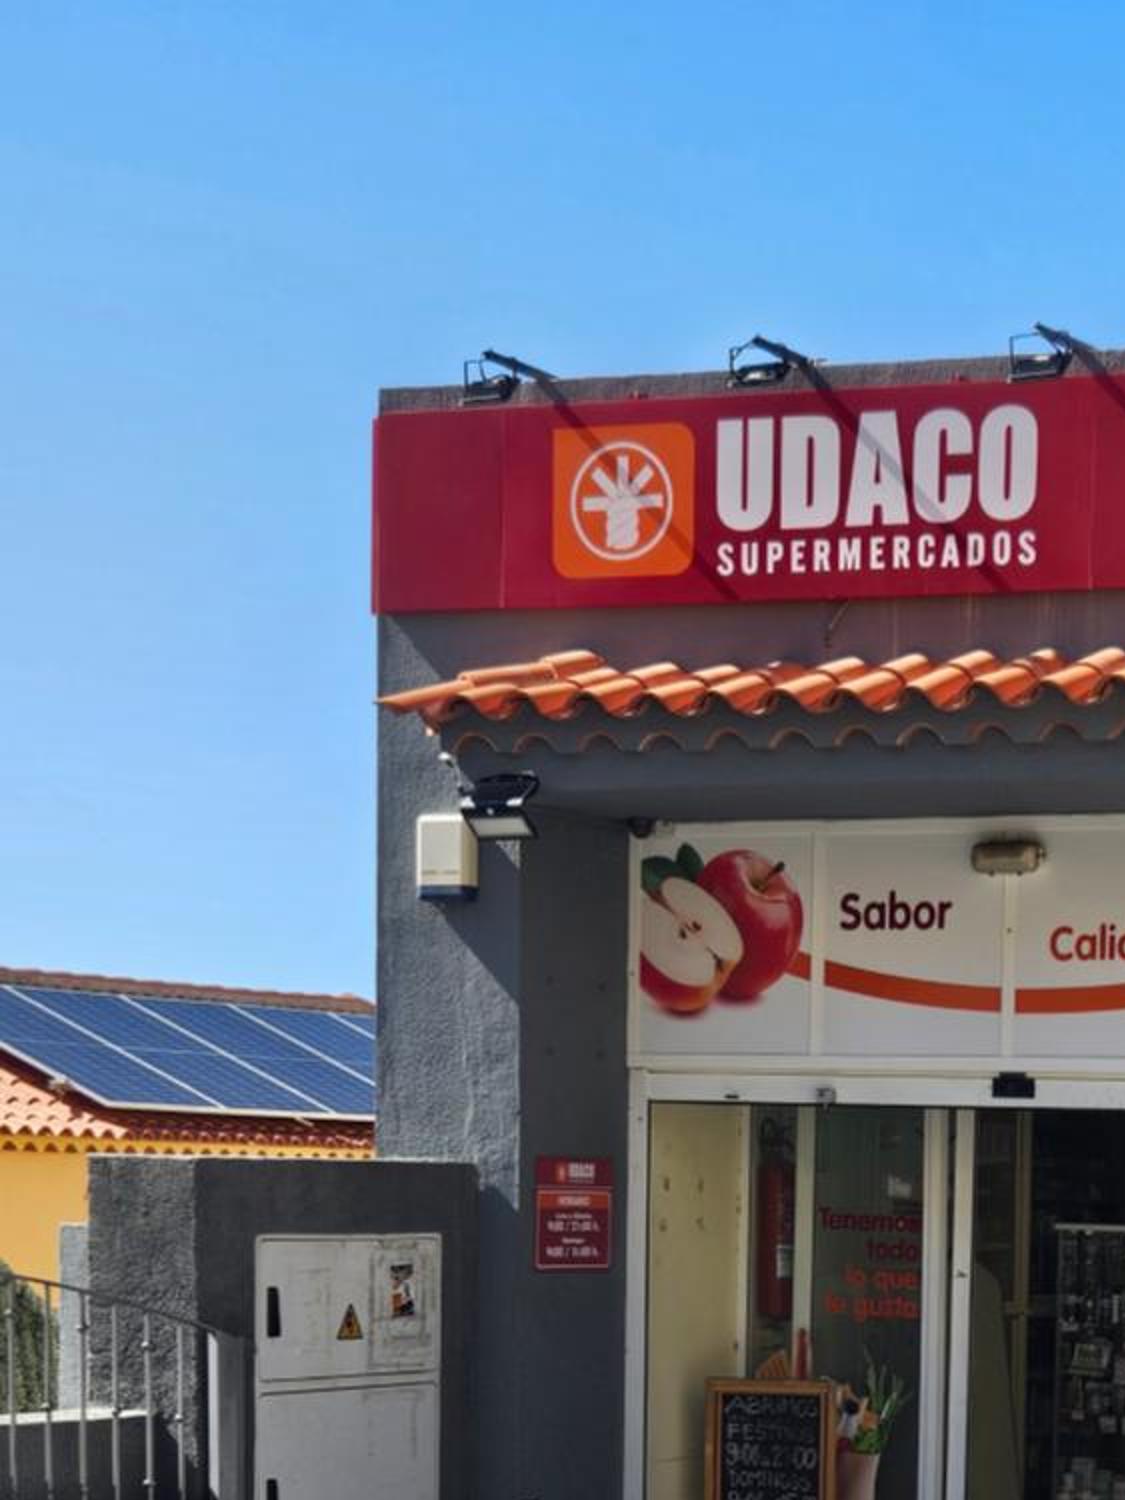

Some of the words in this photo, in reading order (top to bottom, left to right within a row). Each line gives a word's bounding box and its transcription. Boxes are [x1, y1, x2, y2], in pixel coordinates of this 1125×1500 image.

[717, 405, 1039, 532] UDACO
[717, 530, 1038, 577] SUPERMERCADOS
[839, 889, 954, 932] Sabor
